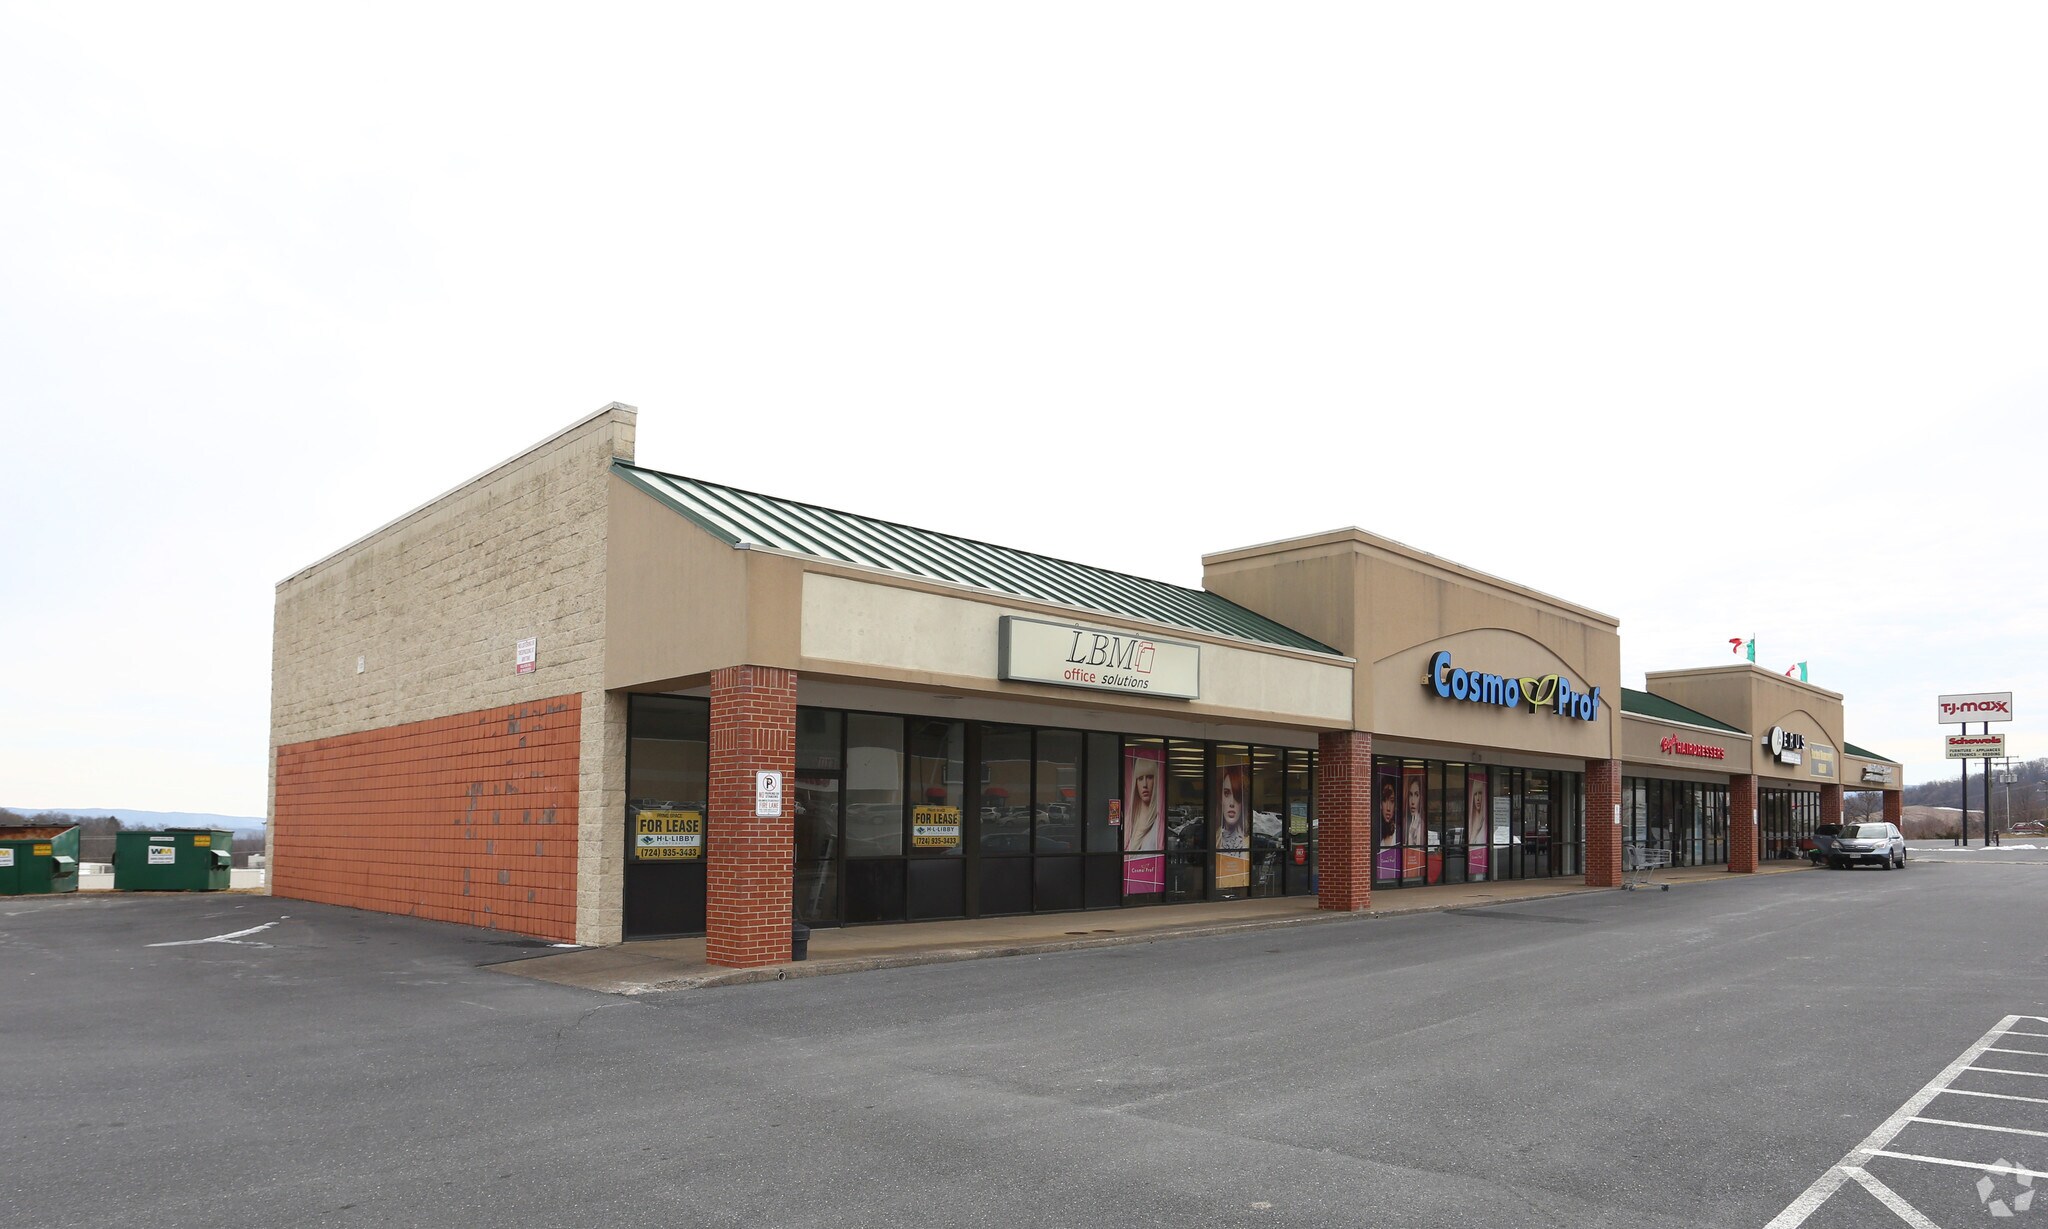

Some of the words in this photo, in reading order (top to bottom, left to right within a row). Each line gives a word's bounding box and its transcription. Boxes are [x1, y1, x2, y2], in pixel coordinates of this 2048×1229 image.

[1066, 630, 1138, 670] LBM
[1064, 668, 1096, 683] office
[1101, 674, 1149, 689] solutions
[1430, 651, 1519, 708] Cosmo
[1557, 676, 1600, 722] Prof
[1676, 742, 1725, 759] HAIRDRESSERS
[640, 820, 662, 832] FOR
[666, 820, 698, 832] LEASE
[915, 813, 931, 824] FOR
[934, 813, 957, 824] LEASE
[641, 848, 660, 857] (724)
[662, 848, 697, 856] 935-3433
